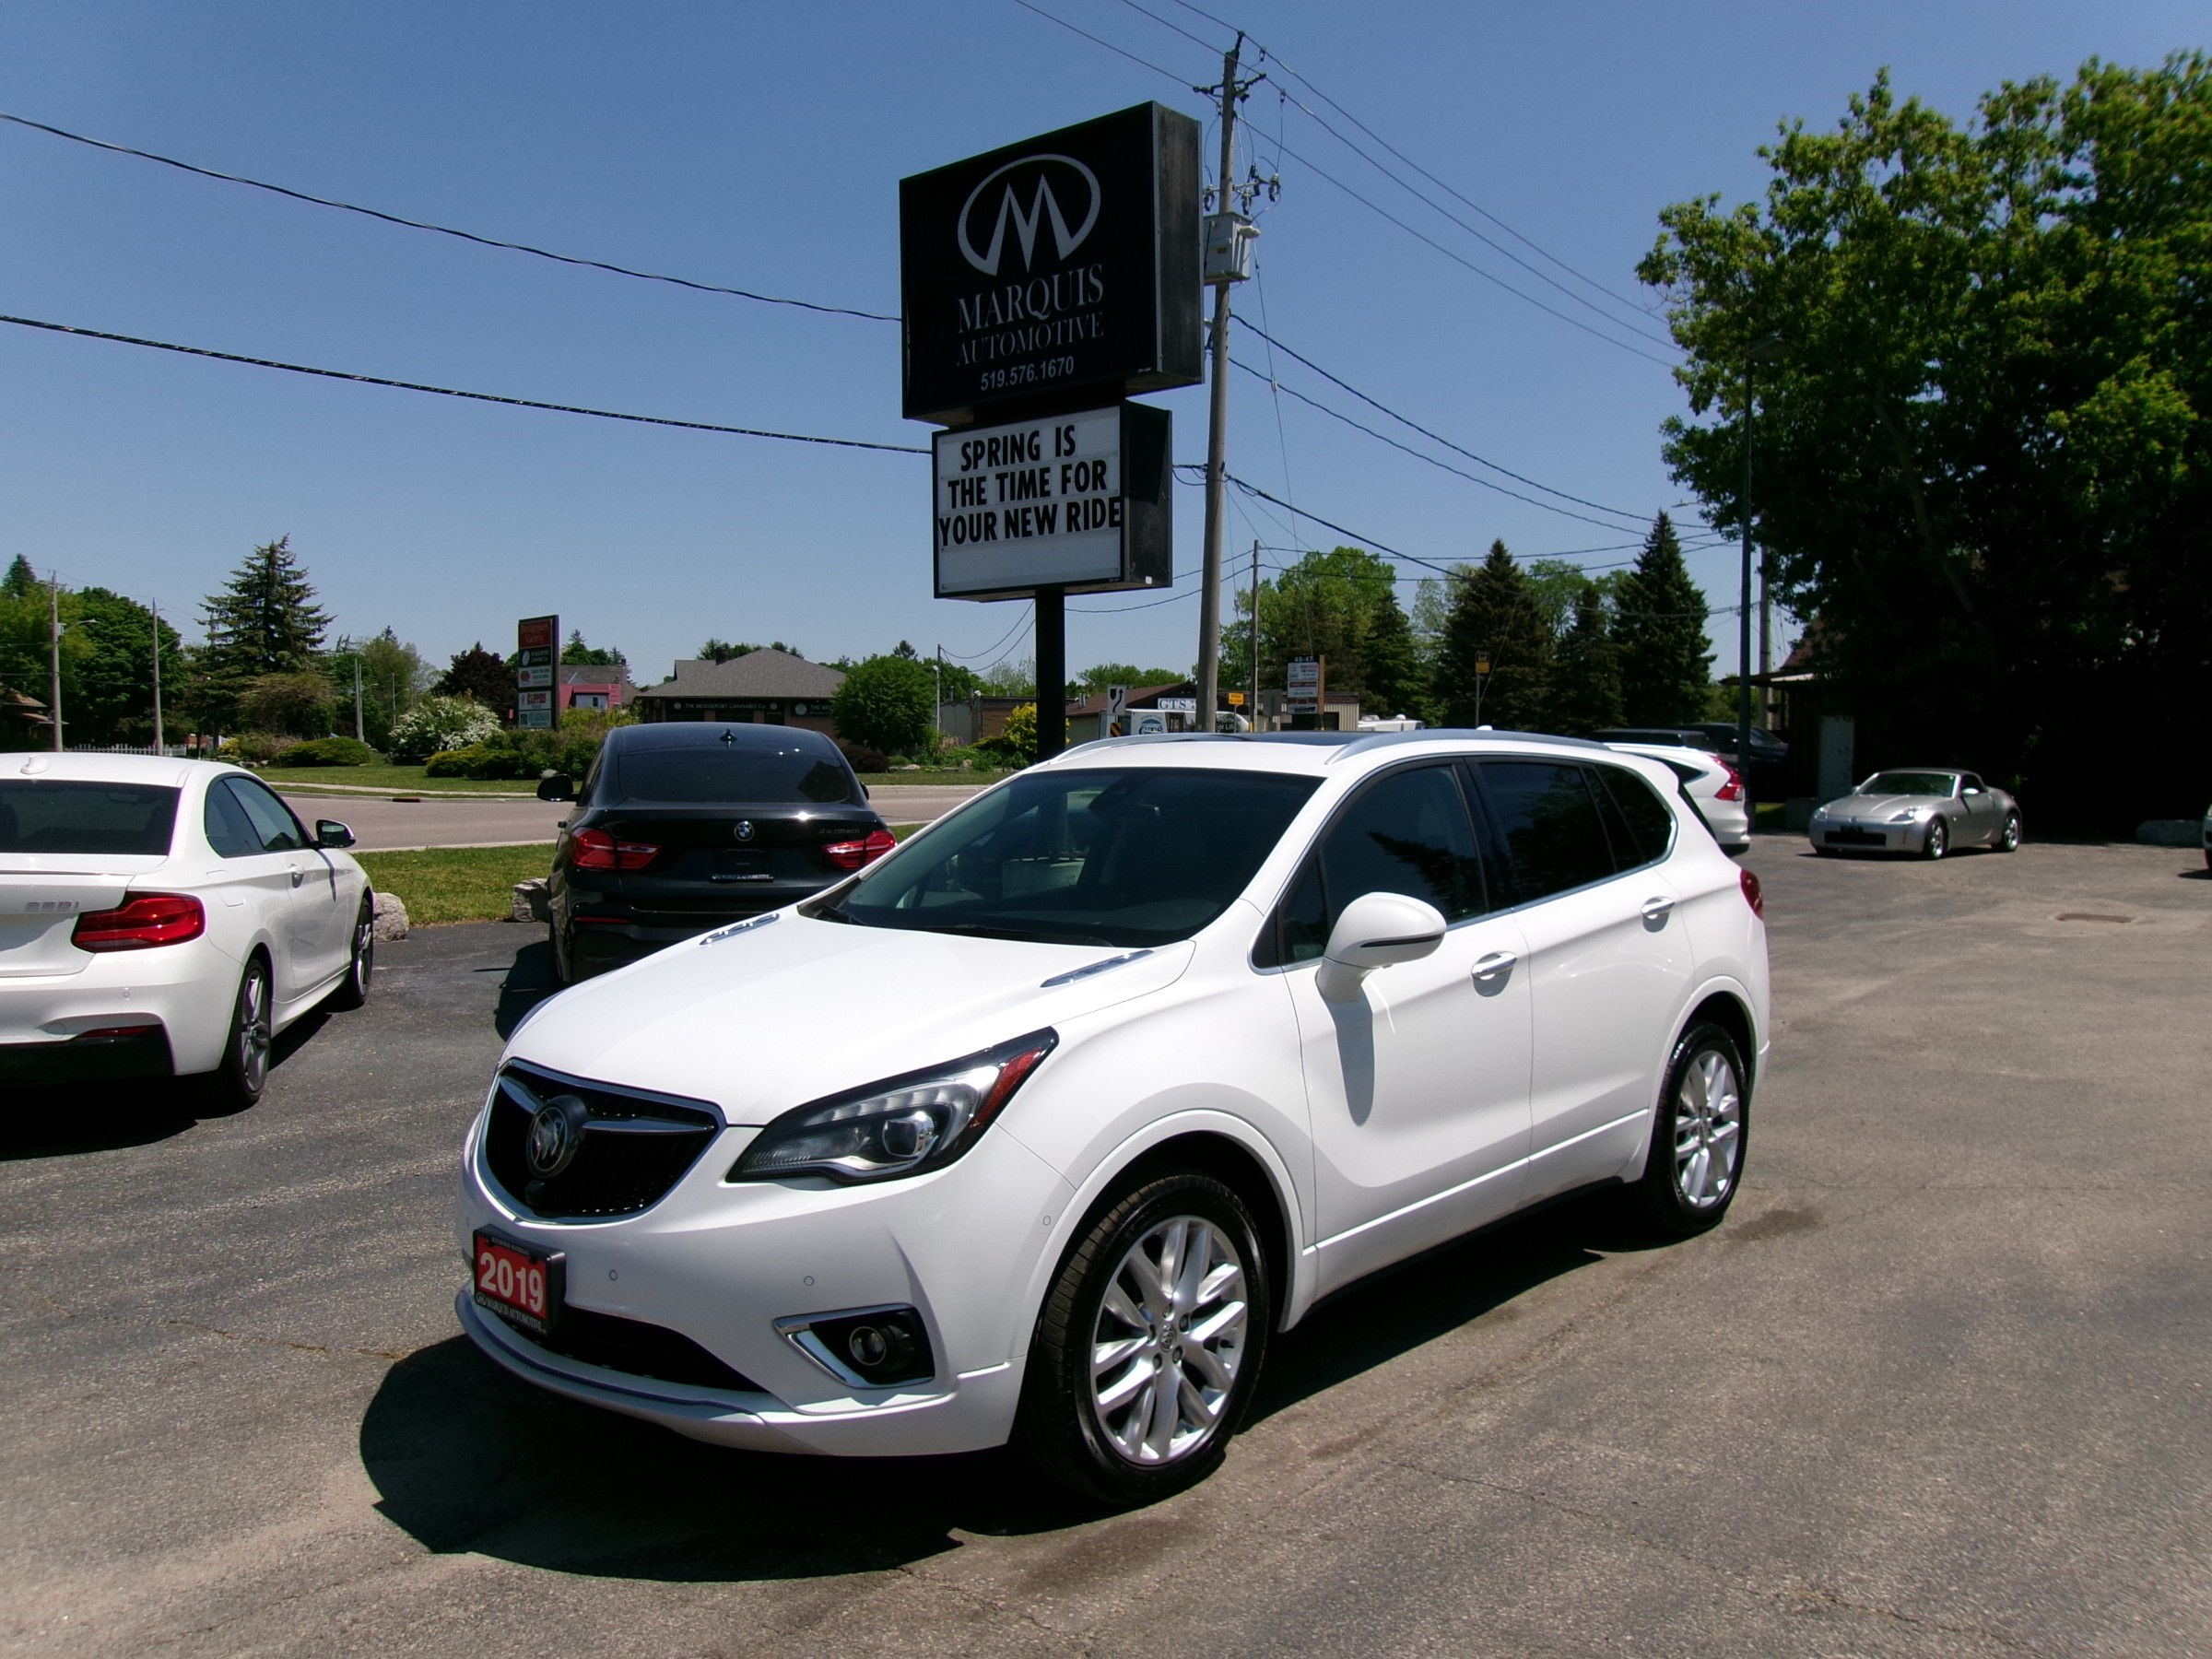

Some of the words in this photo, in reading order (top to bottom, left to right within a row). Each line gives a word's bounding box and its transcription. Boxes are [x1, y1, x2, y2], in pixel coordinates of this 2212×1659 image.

[958, 264, 1104, 334] MARQUIS
[957, 311, 1104, 367] AUTOMOTIVE
[980, 355, 1075, 392] 519.576.1670
[960, 429, 1041, 472] SPRING
[1055, 424, 1077, 457] IS
[947, 475, 987, 509] THE
[995, 466, 1051, 502] TIME
[1061, 459, 1107, 495] FOR
[939, 512, 997, 547] YOUR
[1005, 503, 1058, 539] NEW
[1066, 496, 1122, 533] RIDE
[1159, 699, 1186, 710] GTS
[480, 1253, 543, 1312] 2019
